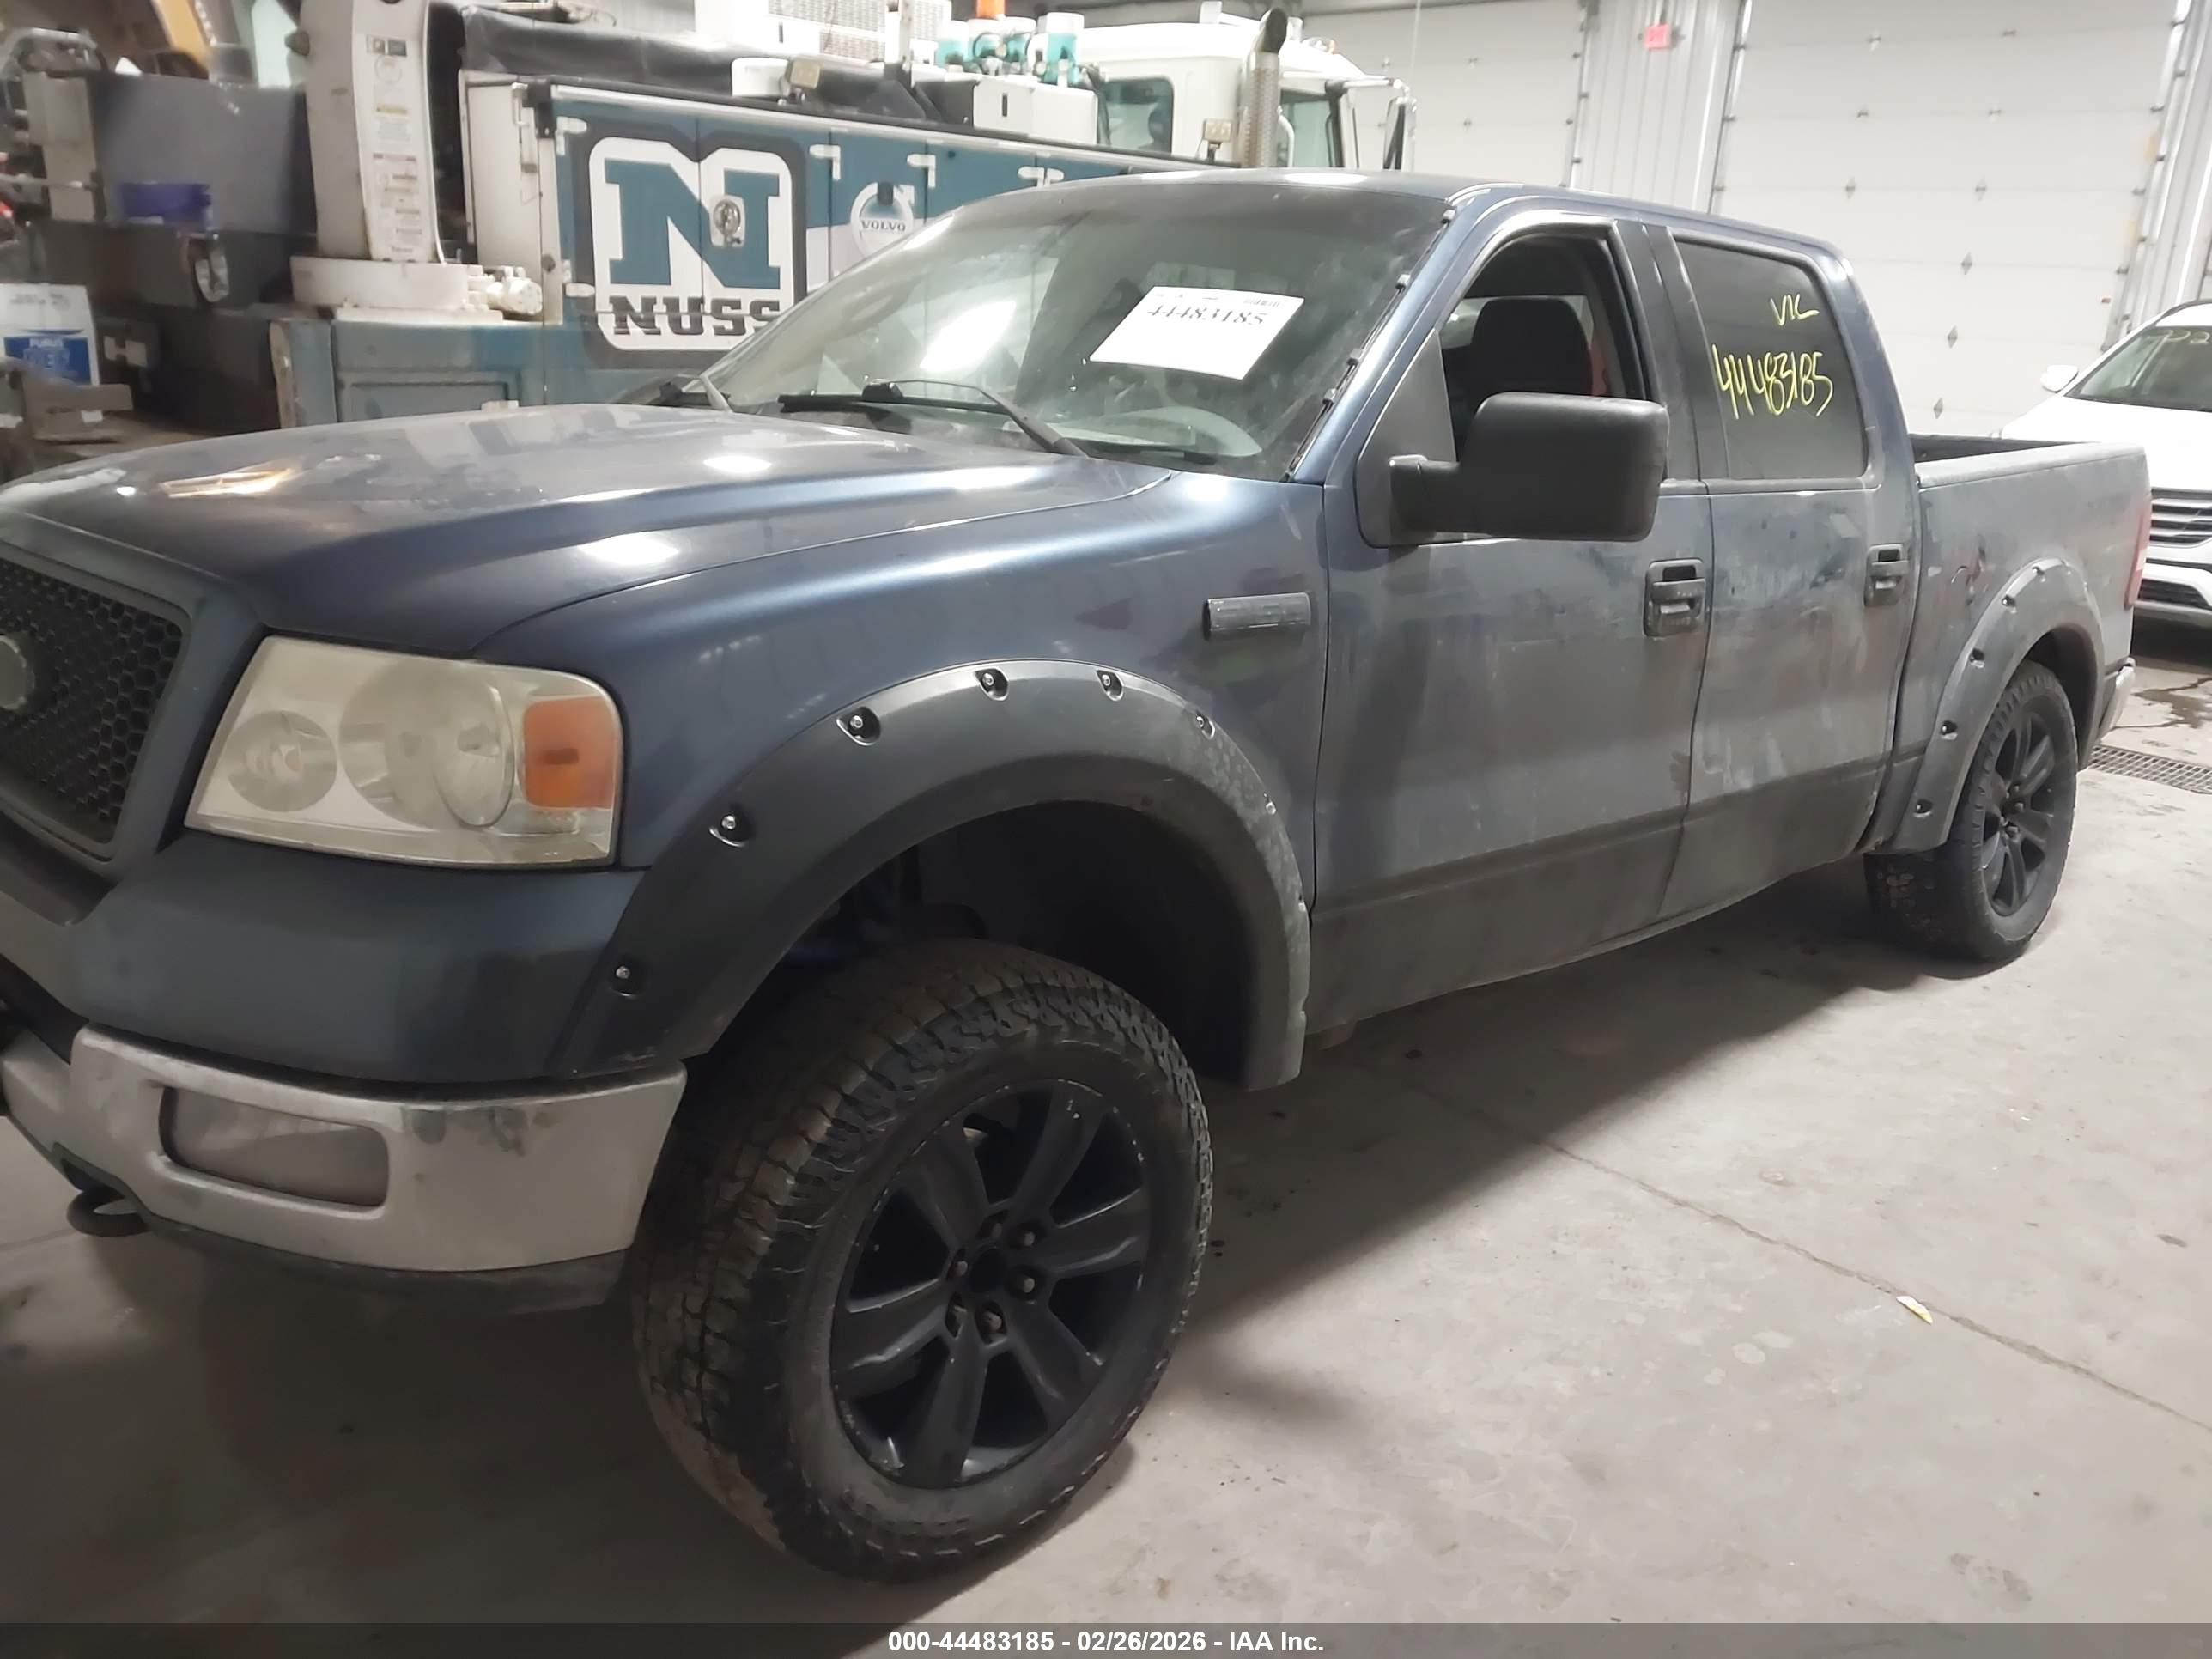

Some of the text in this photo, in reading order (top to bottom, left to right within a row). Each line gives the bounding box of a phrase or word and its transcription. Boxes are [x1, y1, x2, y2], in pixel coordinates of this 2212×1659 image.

[605, 158, 780, 289] N
[861, 220, 906, 232] VOLVO
[609, 295, 780, 336] NUSS
[1711, 343, 1833, 420] 44483185
